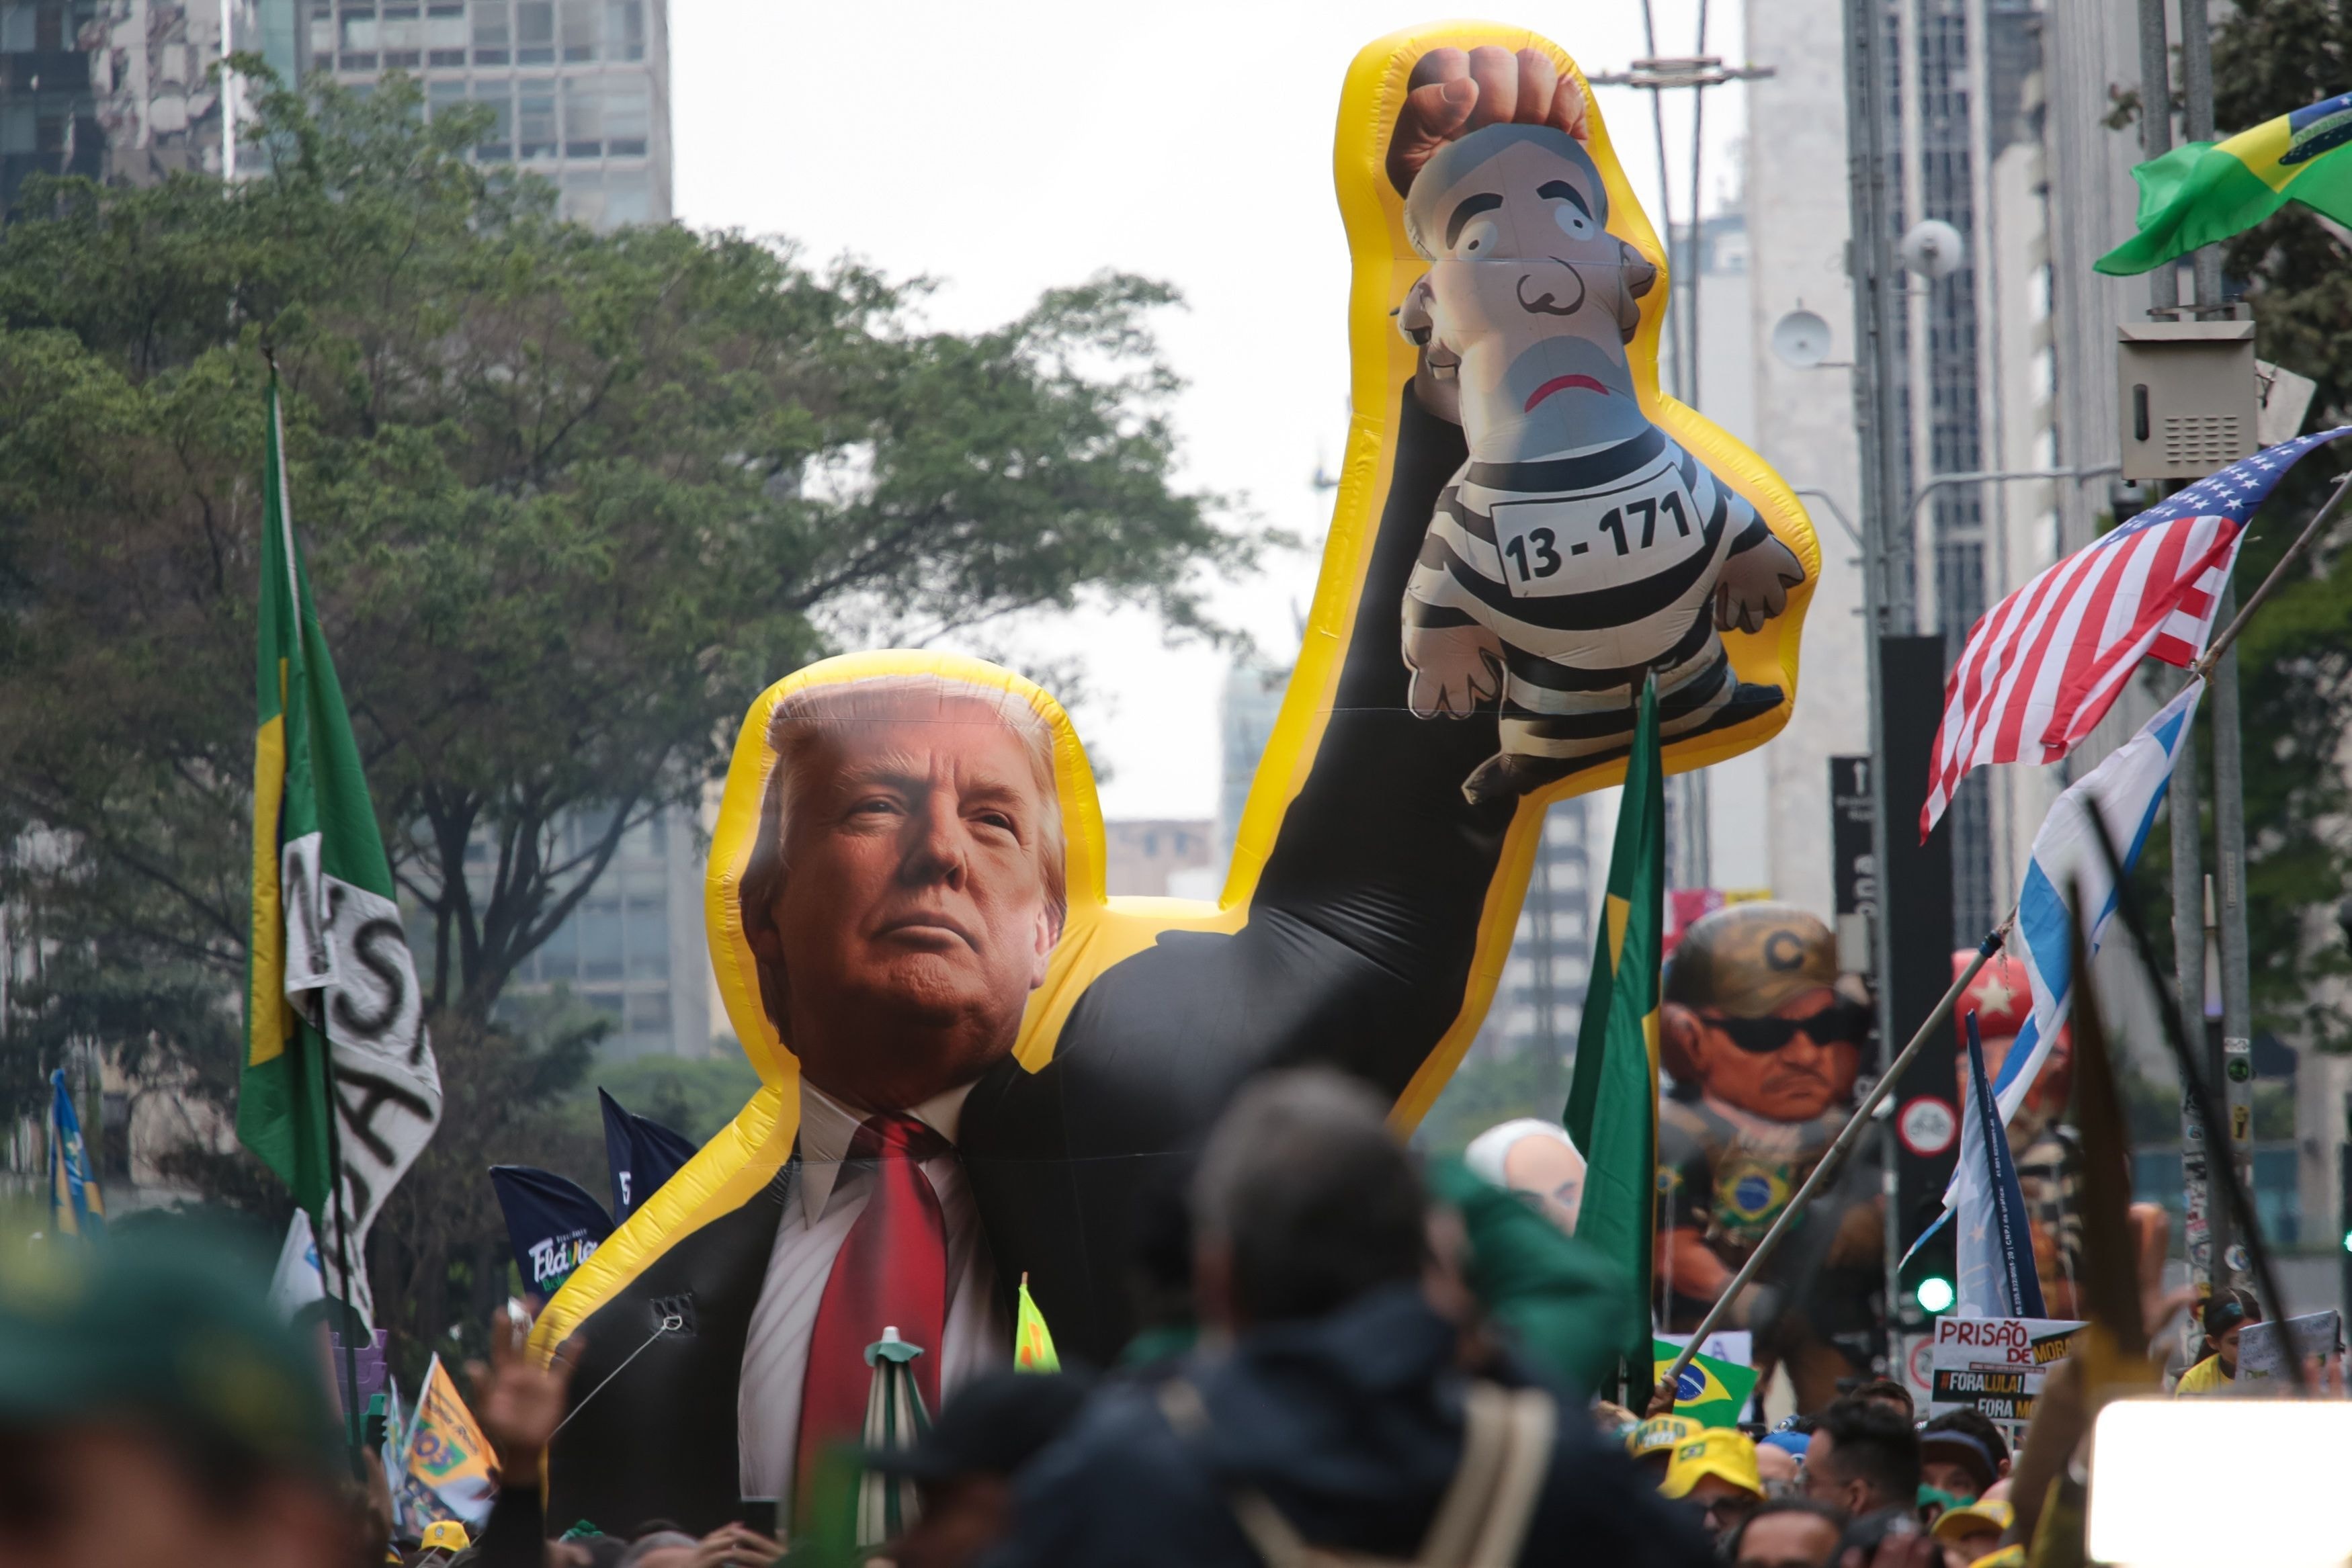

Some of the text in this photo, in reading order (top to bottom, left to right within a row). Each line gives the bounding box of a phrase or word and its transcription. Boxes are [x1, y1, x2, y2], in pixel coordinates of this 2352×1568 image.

[2004, 1225, 2013, 1245] CNPJ
[1940, 1320, 2028, 1348] PRISÃO
[2007, 1337, 2074, 1364] DE MORA
[1978, 1397, 2013, 1418] FORA
